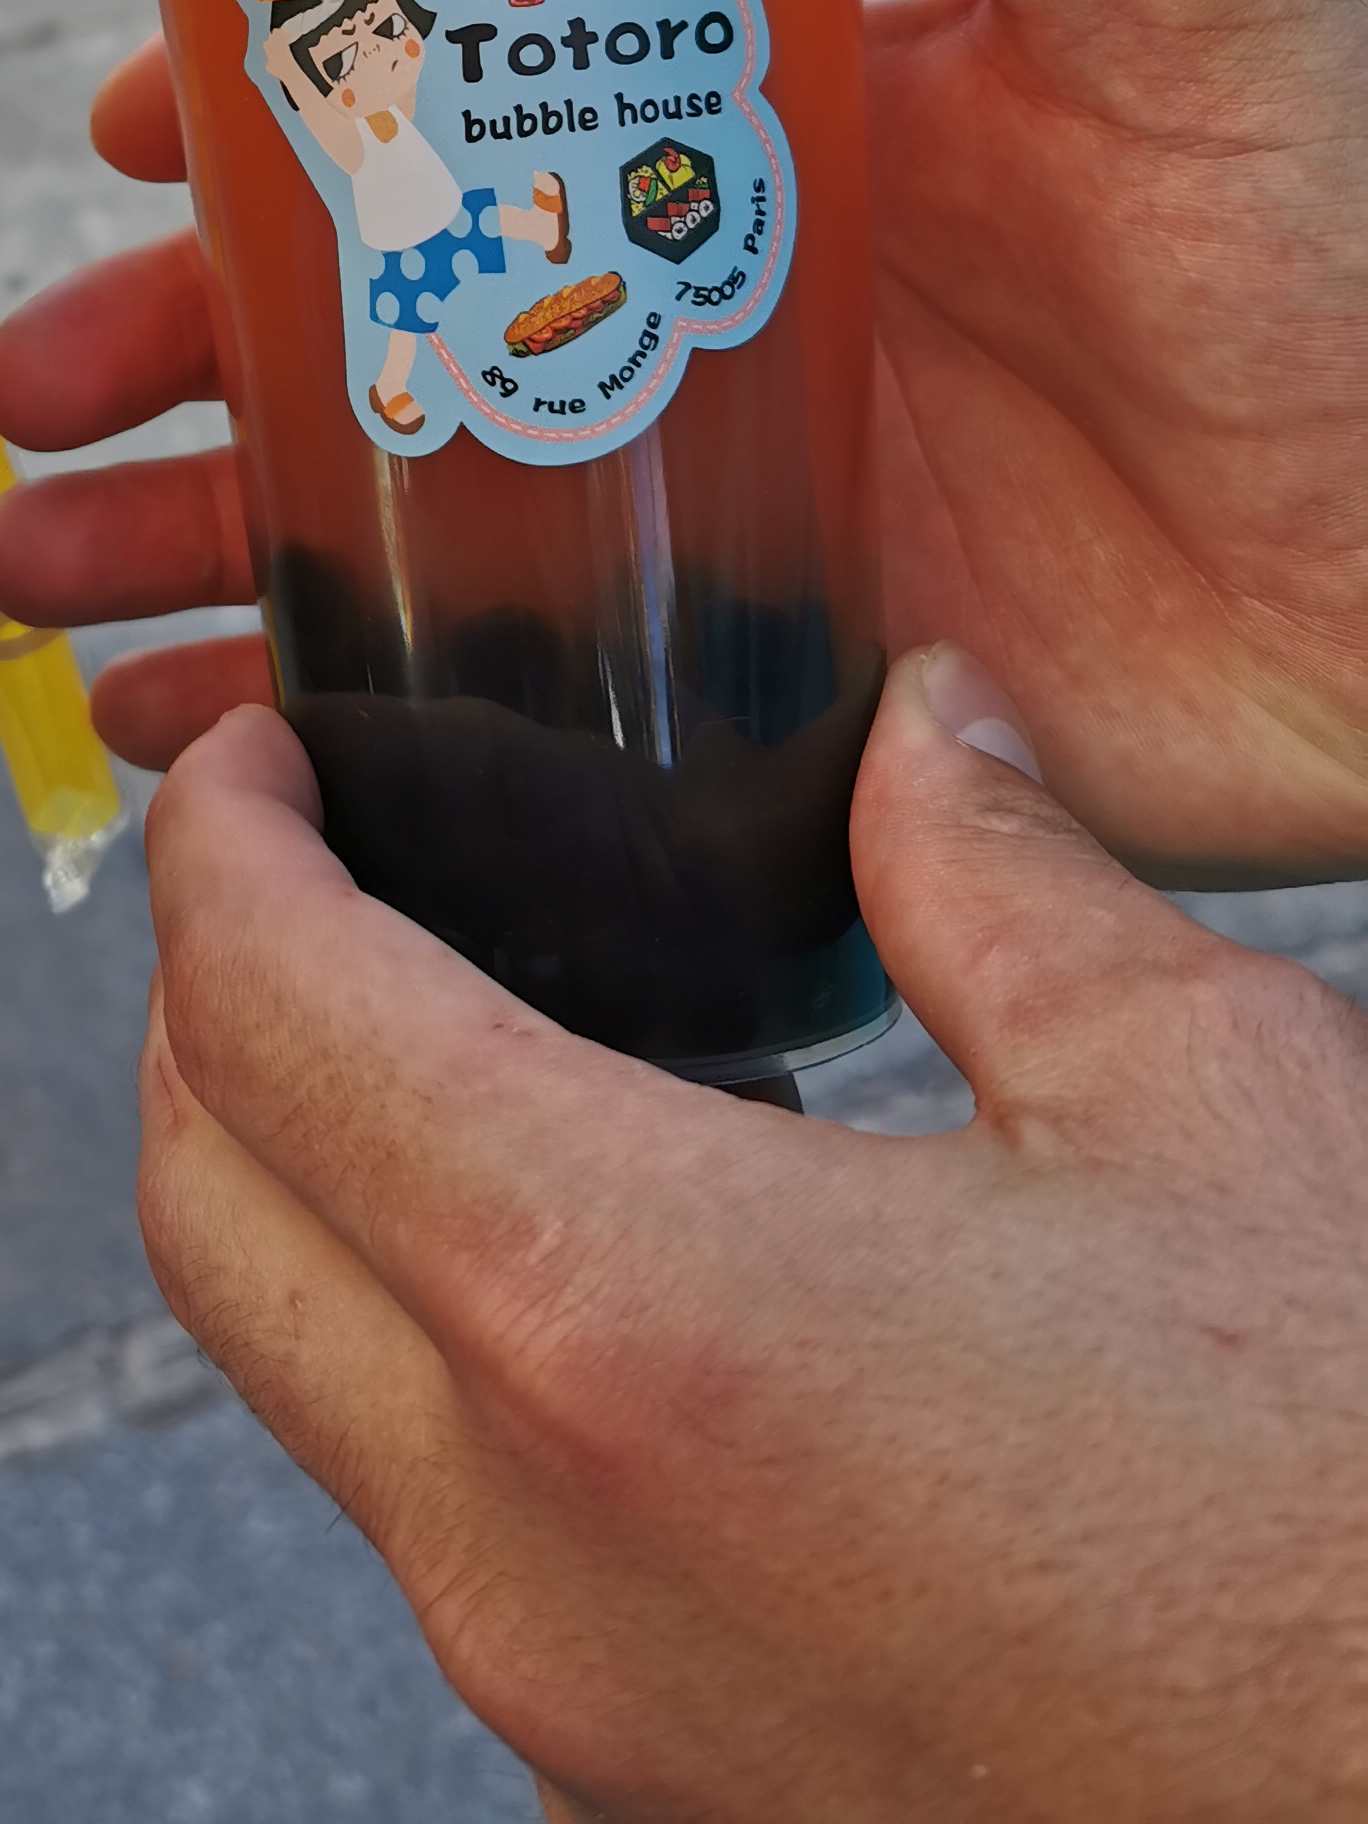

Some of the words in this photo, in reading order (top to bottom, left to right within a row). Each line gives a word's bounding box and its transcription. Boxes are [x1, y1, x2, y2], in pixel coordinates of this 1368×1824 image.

[444, 11, 734, 83] Totoro
[461, 98, 599, 144] bubble
[613, 90, 723, 128] house
[480, 365, 519, 399] 89
[532, 397, 588, 417] rue
[597, 310, 662, 400] Monge
[674, 265, 748, 307] 75005
[743, 177, 767, 256] Paris
